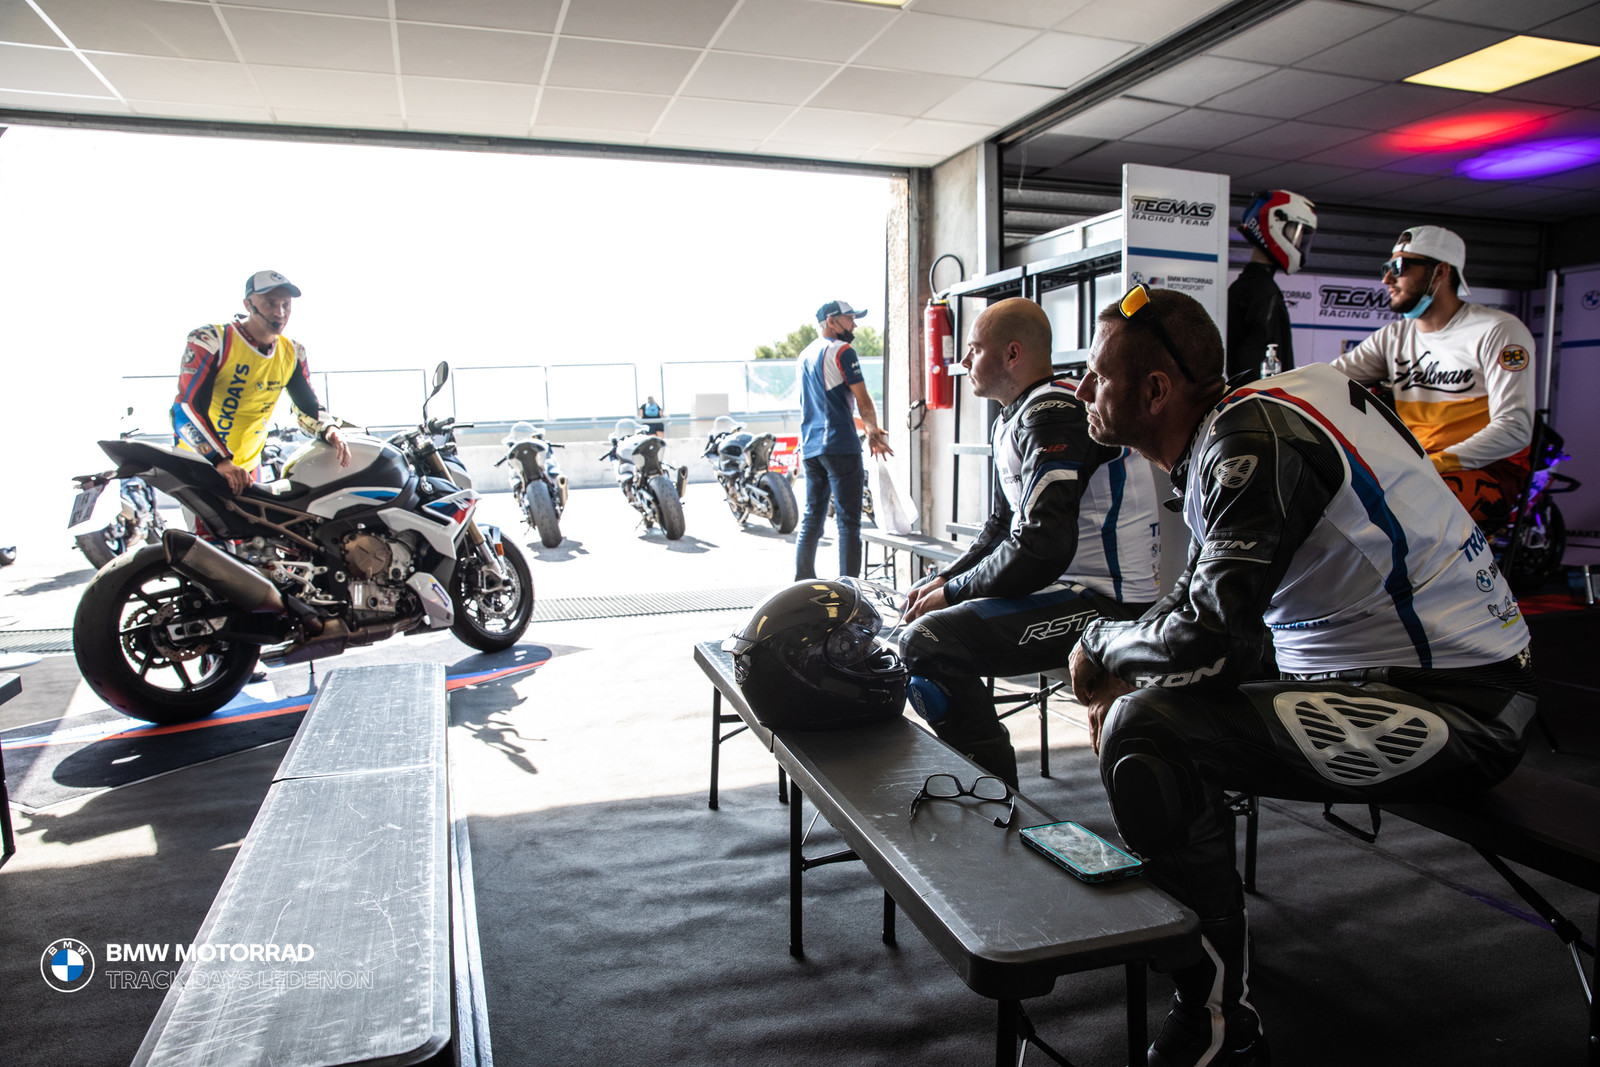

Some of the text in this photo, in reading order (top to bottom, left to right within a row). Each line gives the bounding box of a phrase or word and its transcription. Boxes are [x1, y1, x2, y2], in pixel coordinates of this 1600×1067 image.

[1131, 196, 1216, 219] TECMAS
[1132, 213, 1210, 227] RACING TEAM
[1167, 275, 1214, 285] BMW MOTORRAD
[1167, 283, 1205, 291] MOTORSPORT
[1319, 309, 1405, 321] RACING TEA
[1018, 609, 1099, 645] RST
[1135, 656, 1227, 689] IXON
